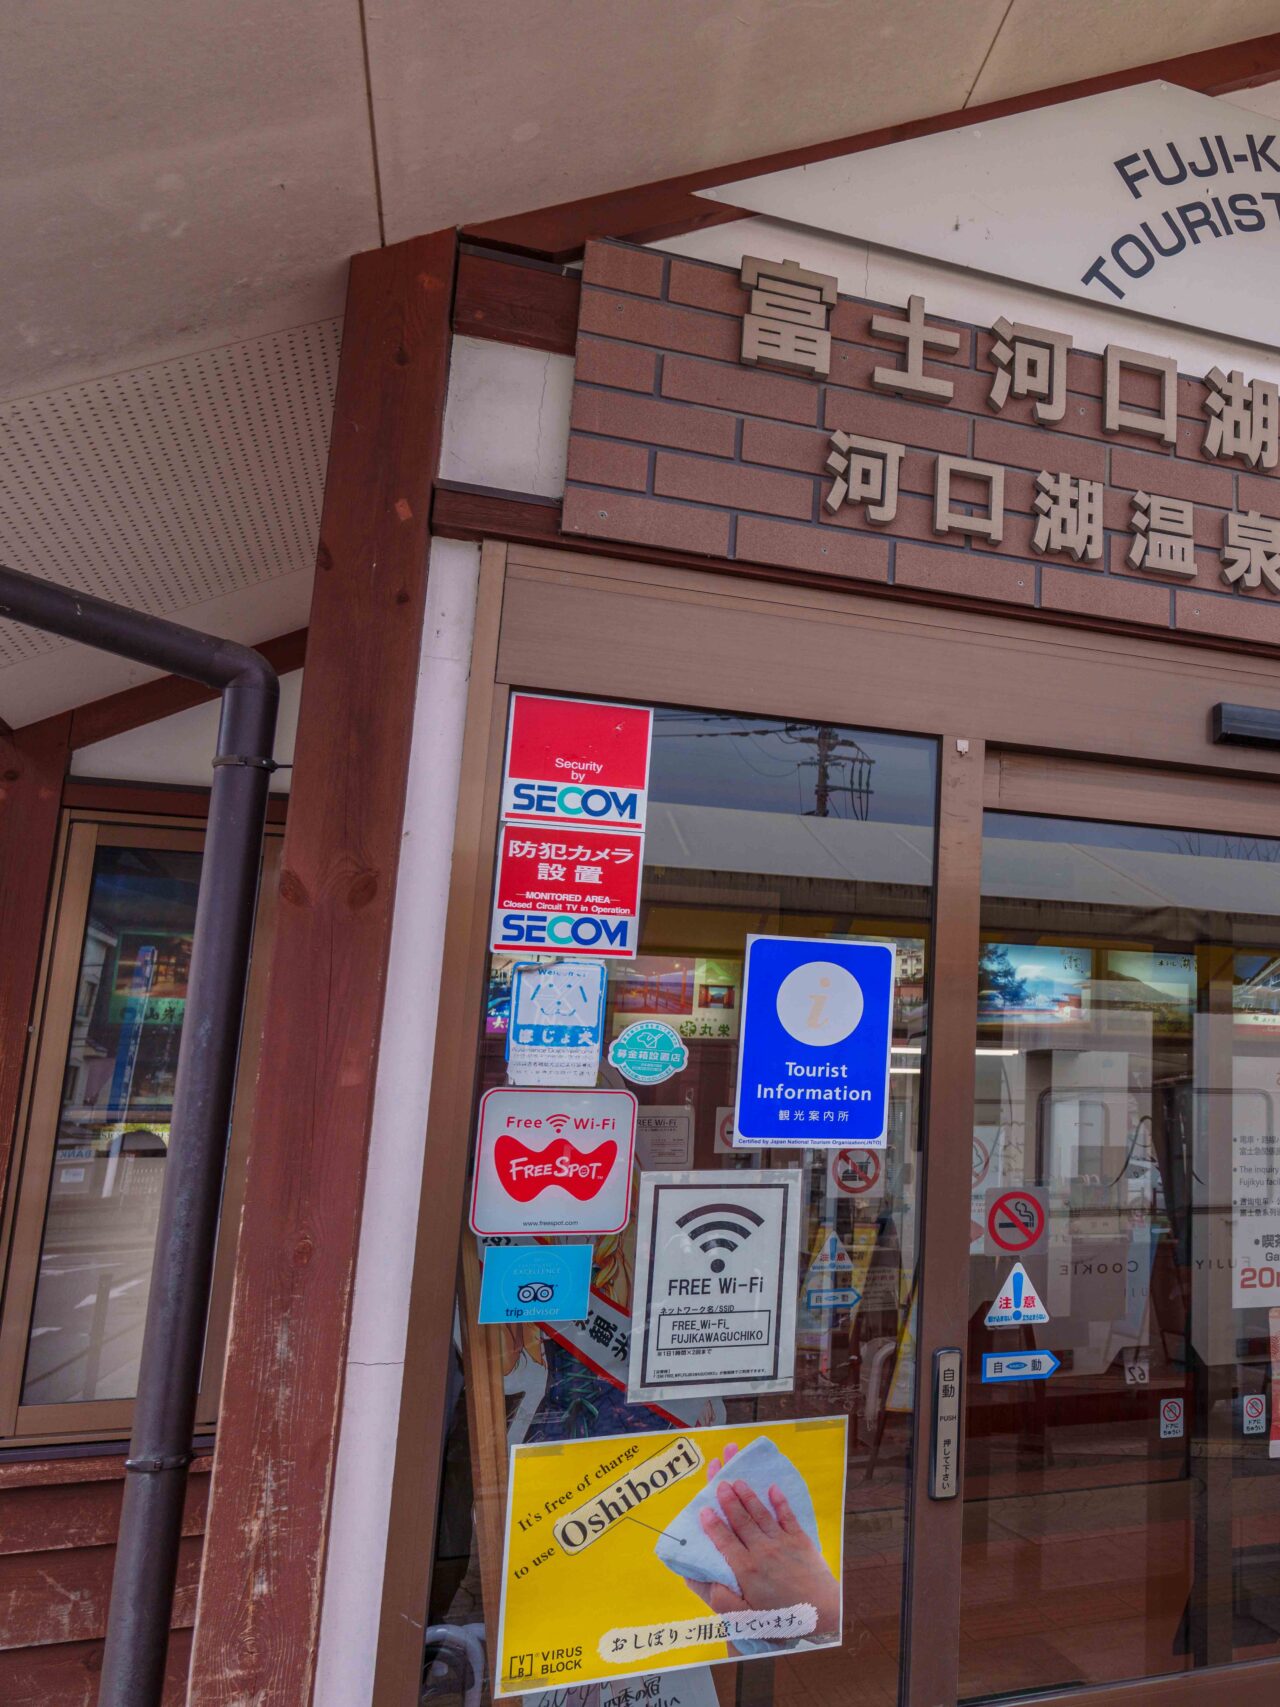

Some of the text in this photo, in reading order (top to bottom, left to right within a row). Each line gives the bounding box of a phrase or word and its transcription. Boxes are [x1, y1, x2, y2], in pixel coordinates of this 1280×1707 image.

[555, 757, 603, 774] Security
[571, 771, 585, 783] by
[513, 783, 637, 820] SECOM
[508, 839, 634, 864] 防犯カメラ
[537, 862, 603, 884] 設置
[525, 891, 611, 904] MONITORED AREA
[503, 900, 630, 914] Closed Circuit TV in Operation
[502, 914, 628, 947] SECOM
[785, 1061, 848, 1078] Tourist
[757, 1083, 871, 1101] Information
[506, 1116, 616, 1130] Free Wi-Fi
[778, 1109, 849, 1122] 観光案内所
[1240, 1165, 1253, 1173] The
[1254, 1165, 1279, 1175] inquiry
[668, 1276, 764, 1296] FREE Wi-Fi
[505, 1306, 560, 1318] tripadvisor
[660, 1304, 735, 1315] ネットワーク名/SSID
[671, 1330, 763, 1345] FUJIKAWAGUCHIKO
[942, 1368, 955, 1398] 自動
[940, 1414, 957, 1422] PUSH
[942, 1438, 952, 1490] 押して下さい
[516, 1443, 640, 1534] It's free of charge
[513, 1442, 698, 1580] to use Oshibori
[611, 1614, 804, 1653] おしぼりご用意しています。
[541, 1645, 583, 1661] VIRUS
[541, 1658, 582, 1675] BLOCK
